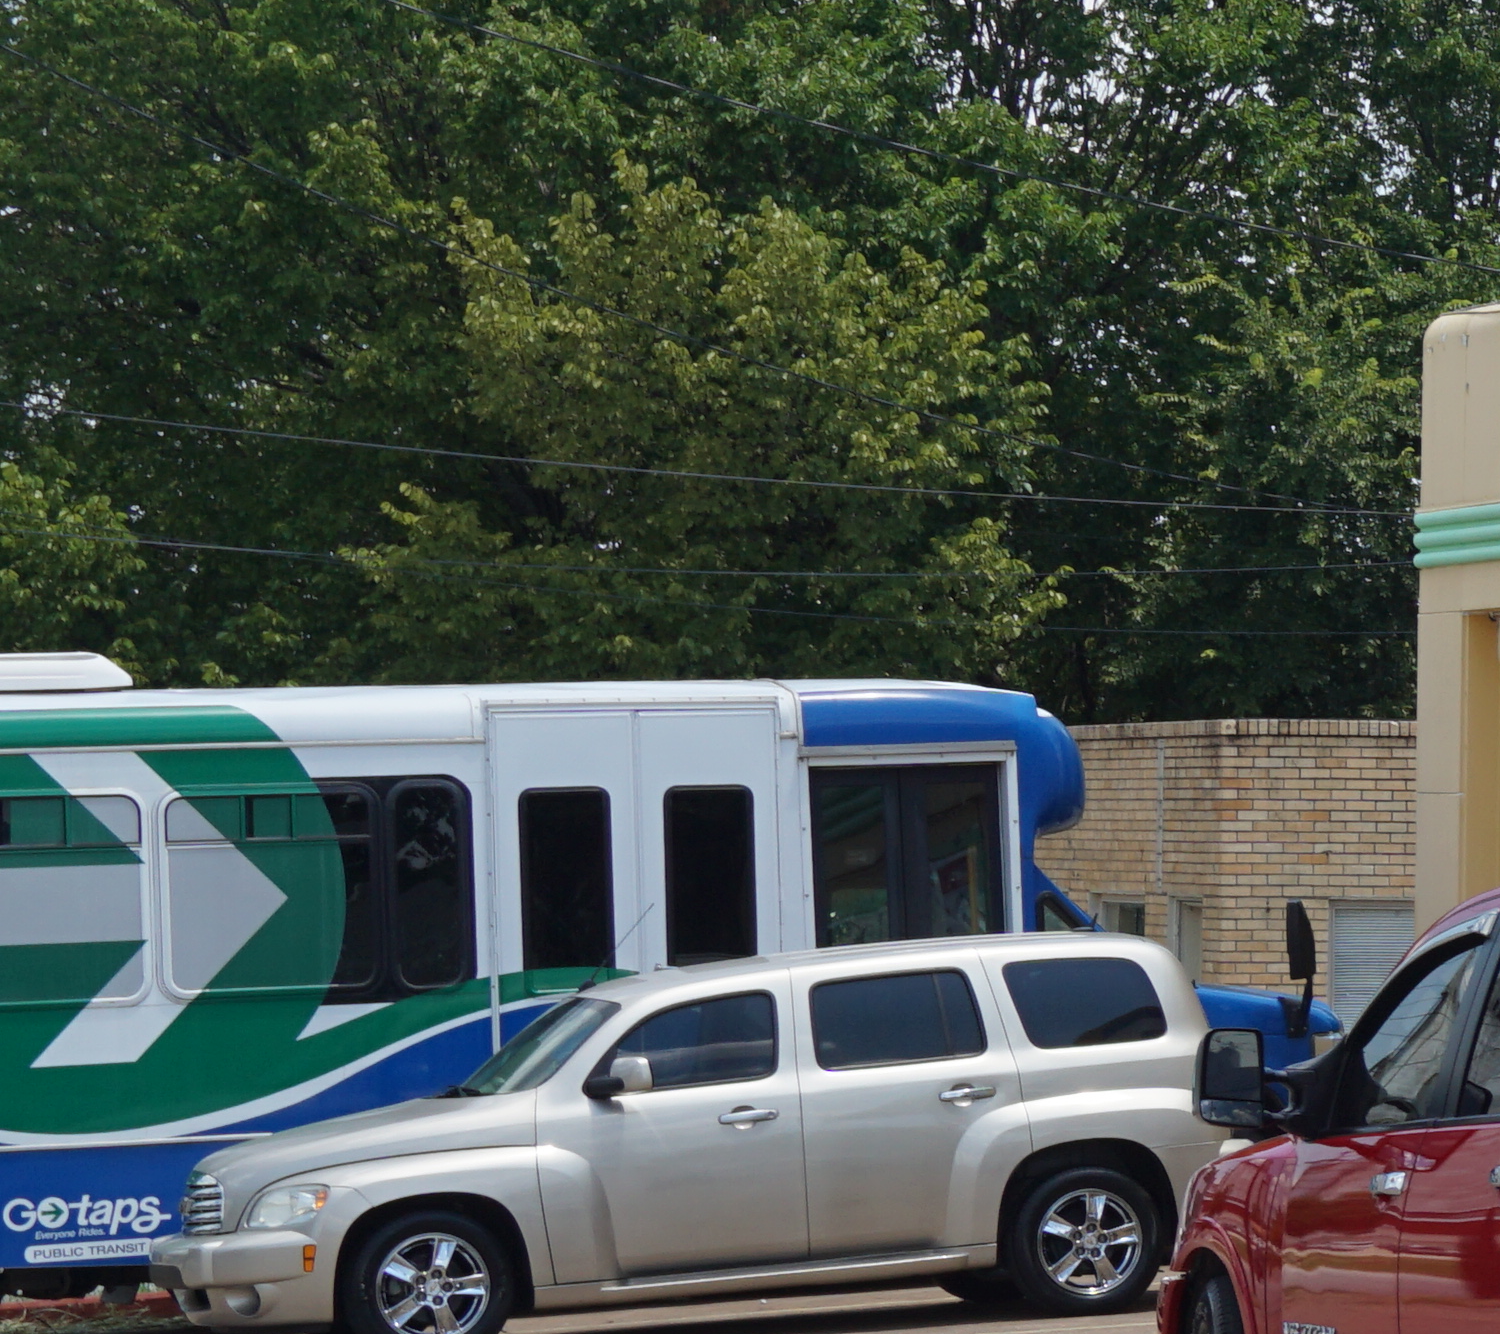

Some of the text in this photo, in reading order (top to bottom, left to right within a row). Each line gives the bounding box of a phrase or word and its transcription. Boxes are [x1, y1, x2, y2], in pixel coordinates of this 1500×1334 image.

[34, 1230, 76, 1240] Everyone
[33, 1242, 146, 1259] PUBLIC TRANSIT
